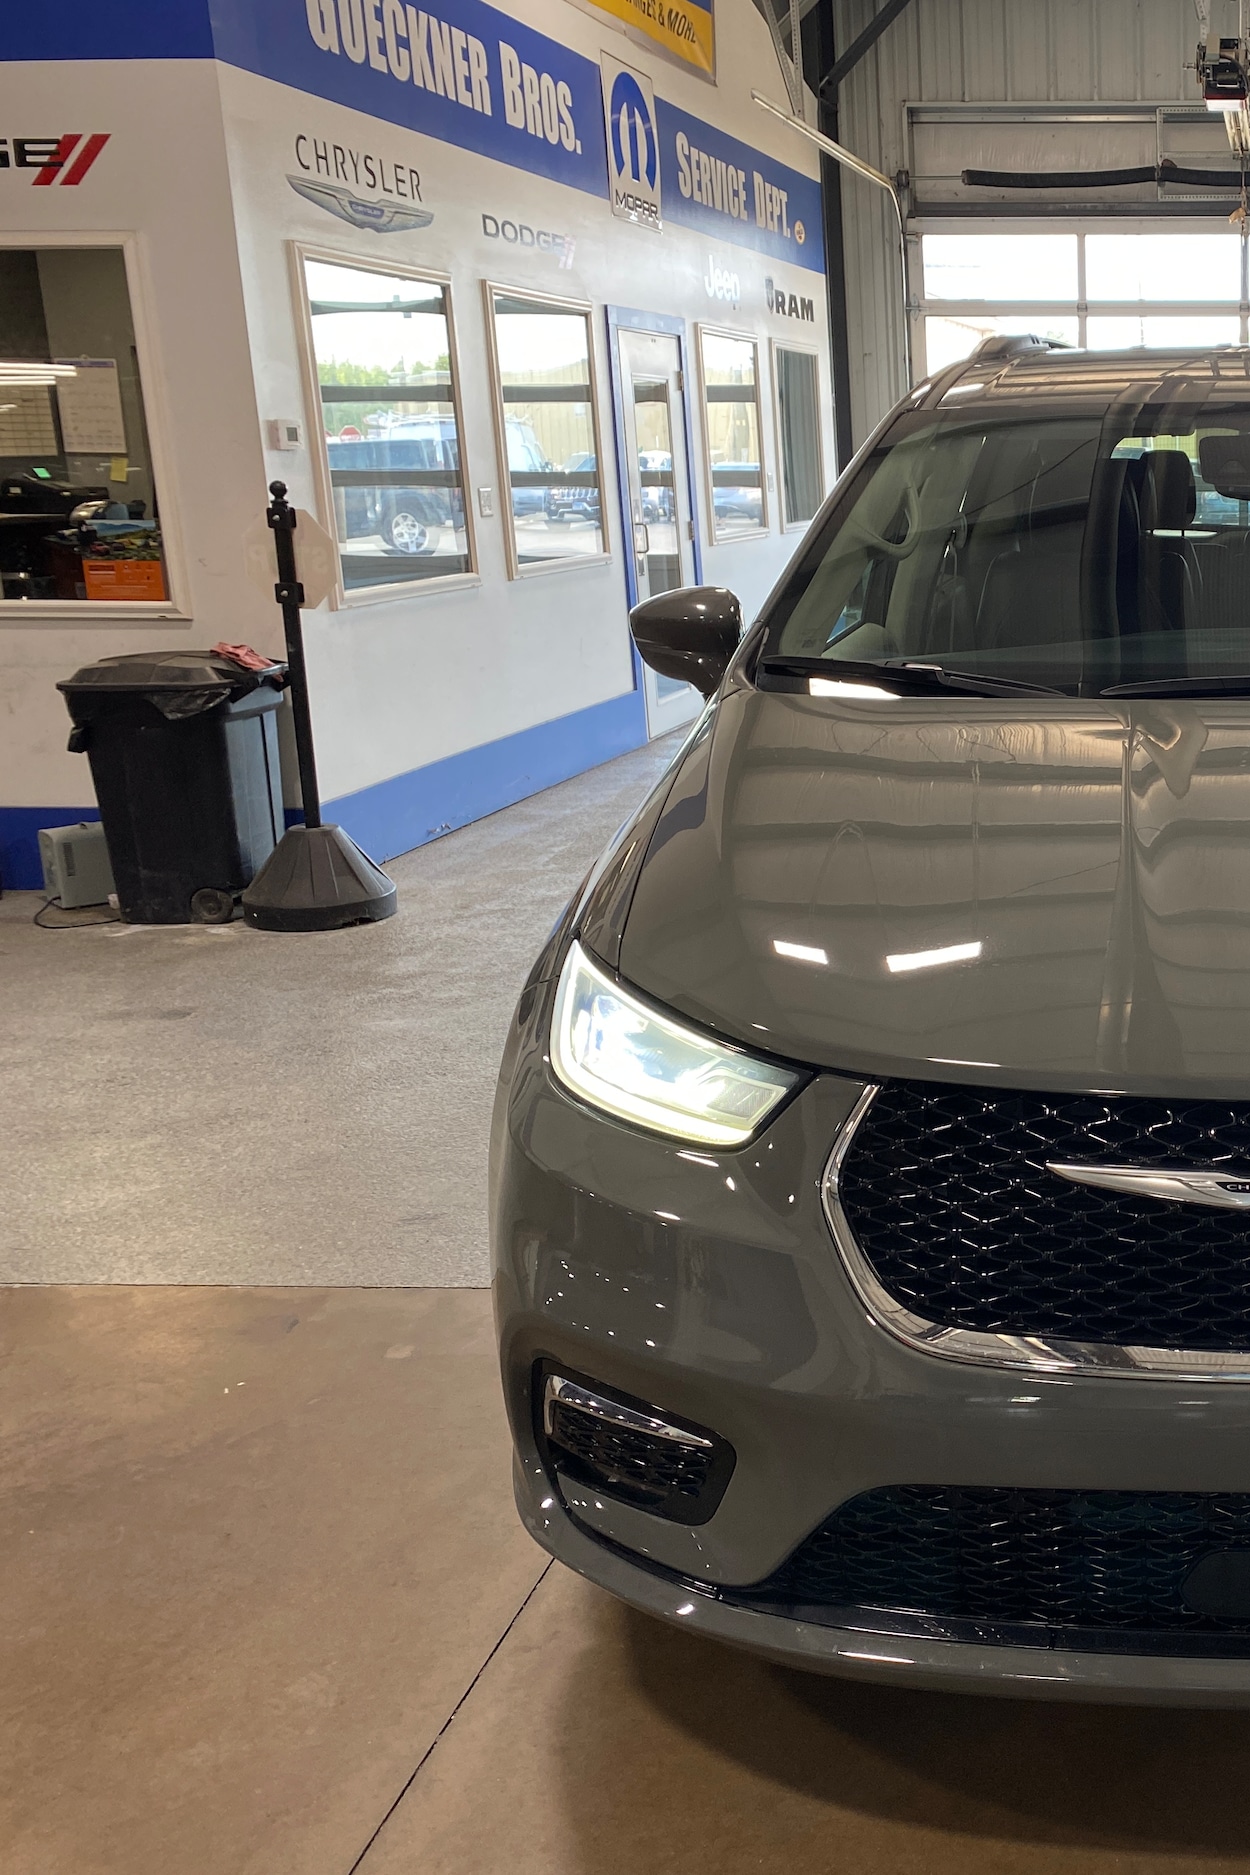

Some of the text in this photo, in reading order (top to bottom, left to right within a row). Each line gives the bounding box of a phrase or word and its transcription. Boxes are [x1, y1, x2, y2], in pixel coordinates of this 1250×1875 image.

[499, 40, 582, 155] BROS.
[295, 134, 422, 202] CHRYSLER
[676, 131, 791, 238] SERVICE DEPT.
[615, 189, 659, 221] MOPAR
[482, 213, 566, 257] DODGE
[704, 254, 741, 309] Jeep
[775, 289, 814, 322] RAM
